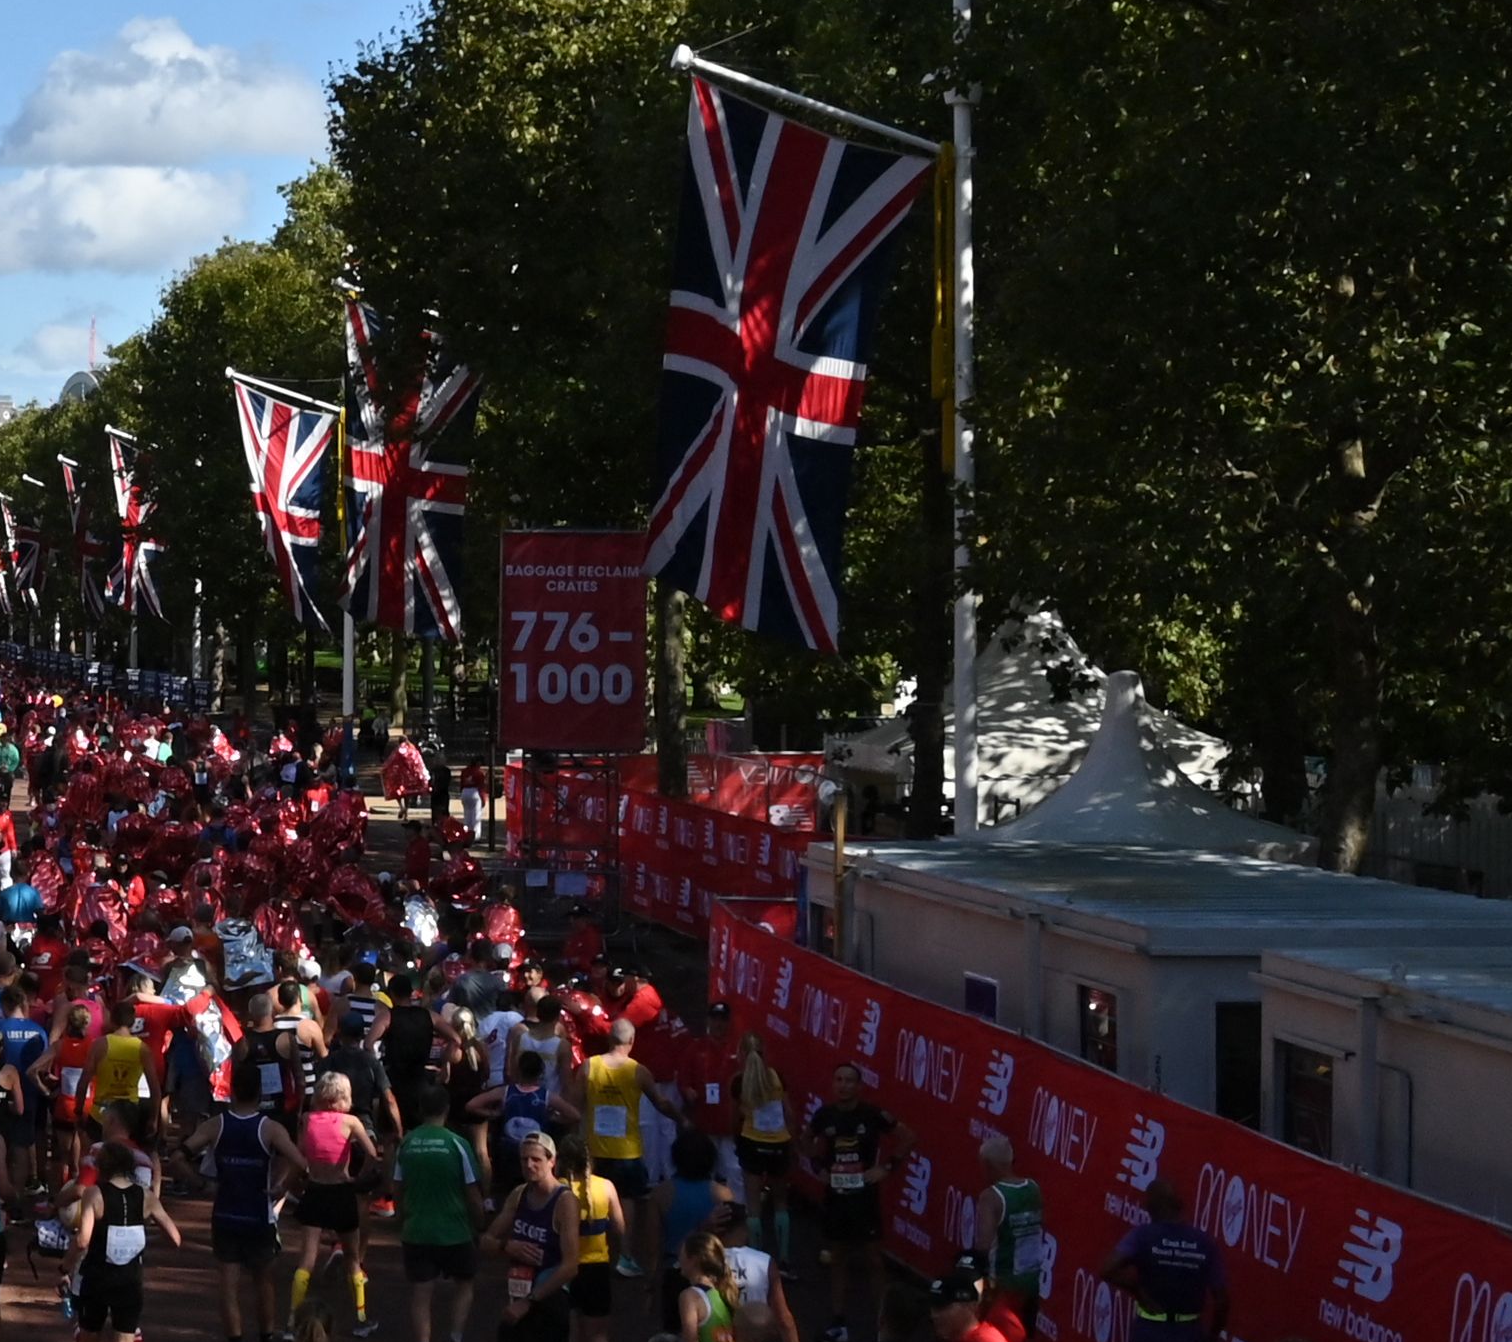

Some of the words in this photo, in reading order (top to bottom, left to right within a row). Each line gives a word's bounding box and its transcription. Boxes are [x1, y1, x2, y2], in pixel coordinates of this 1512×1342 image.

[505, 564, 576, 578] BAGGAGE
[578, 565, 640, 578] RECLAIM
[545, 580, 599, 593] CRATES
[510, 662, 633, 705] 1000
[895, 1027, 964, 1103] MONEY
[1029, 1086, 1098, 1175] MONEY
[1194, 1162, 1306, 1274] MONEY
[1318, 1297, 1342, 1332] new
